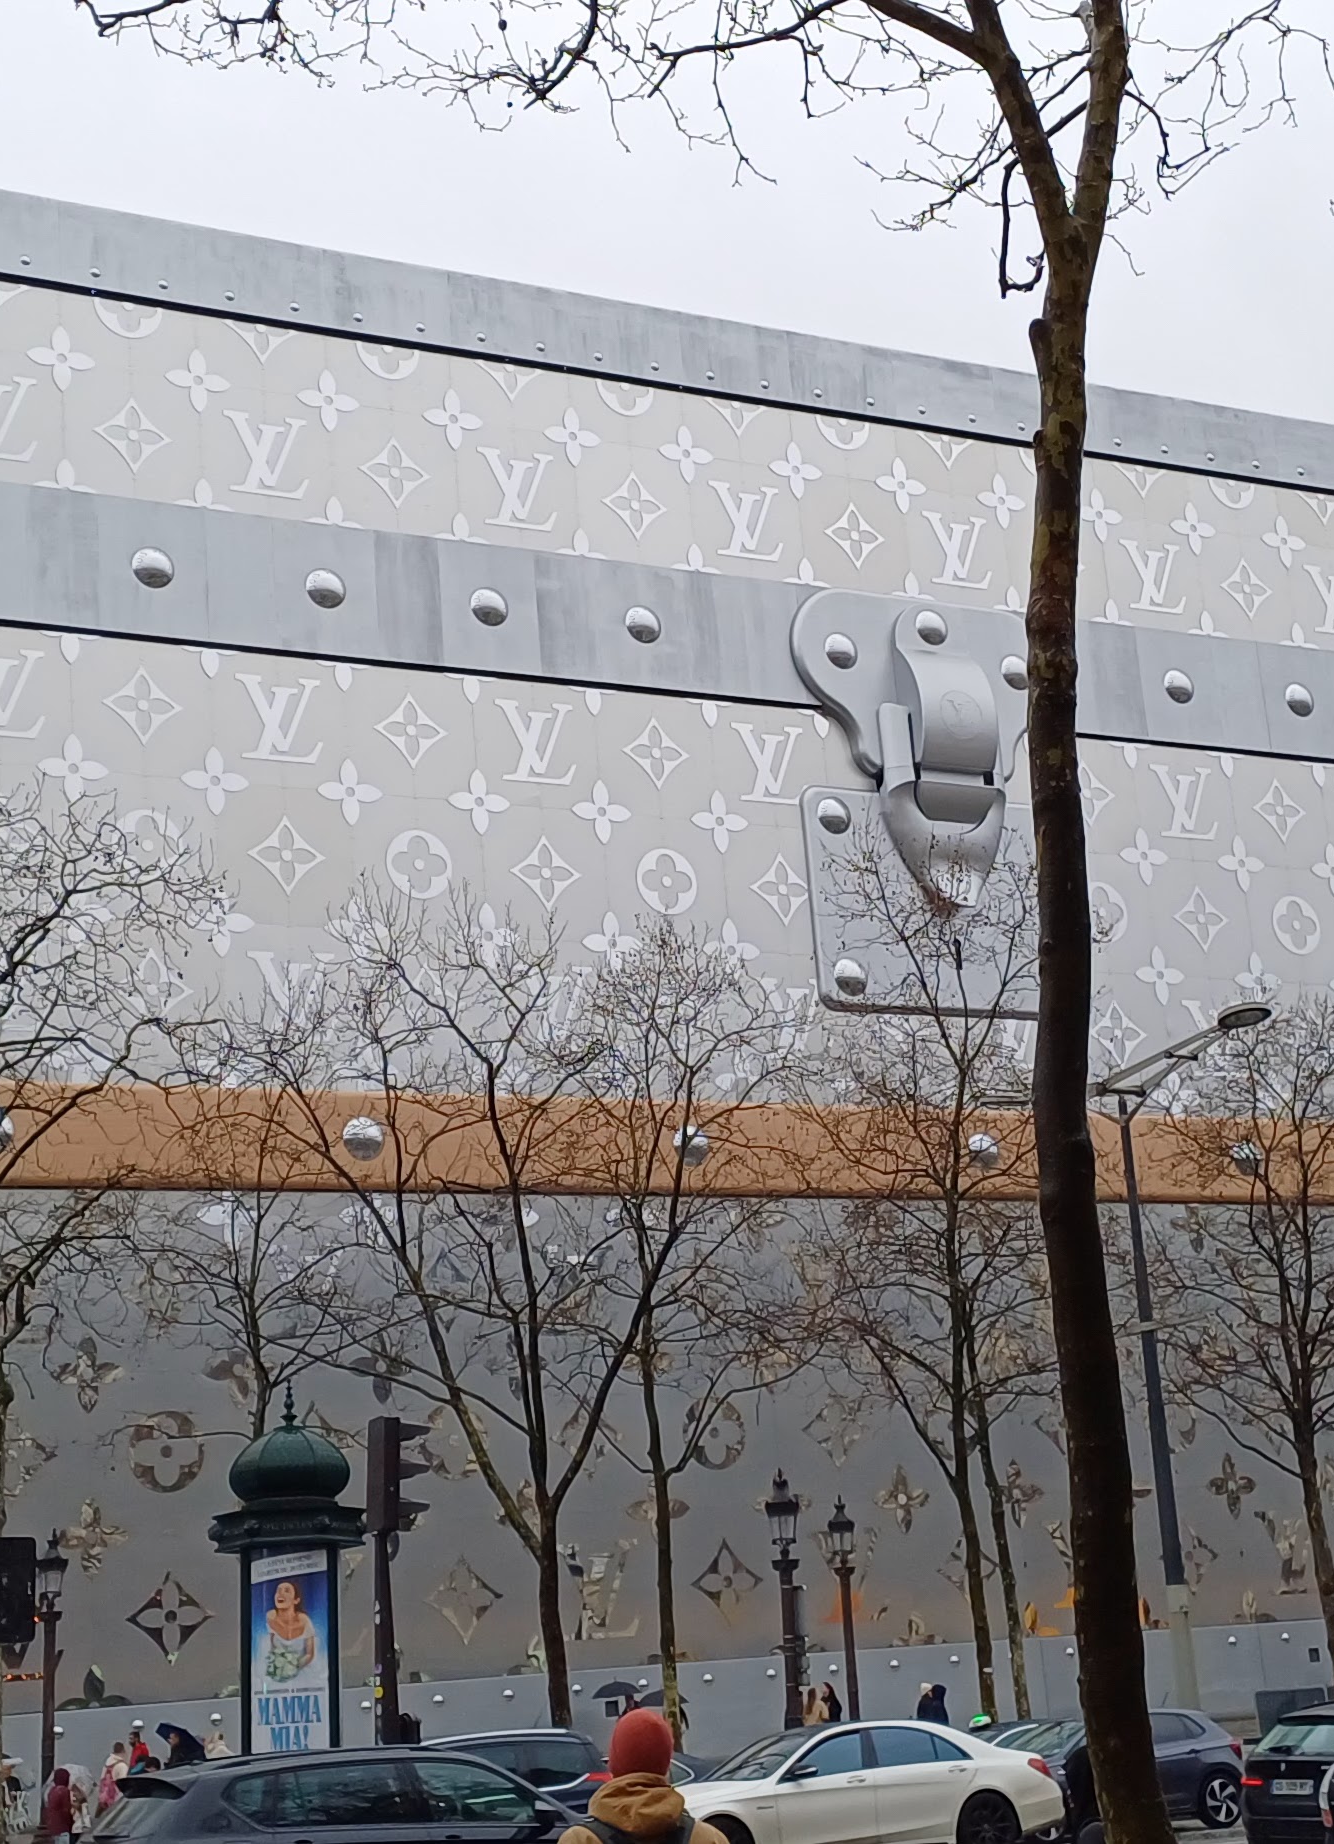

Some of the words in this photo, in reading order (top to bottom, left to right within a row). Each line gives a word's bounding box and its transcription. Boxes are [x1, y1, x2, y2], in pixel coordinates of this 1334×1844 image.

[222, 409, 309, 500] LV
[477, 446, 557, 532] LV
[708, 480, 783, 562] LV
[922, 510, 993, 590] LV
[1119, 538, 1186, 615] LV
[233, 672, 324, 765] LV
[494, 698, 577, 786] LV
[1149, 763, 1219, 841] LV
[257, 1694, 322, 1726] MAMMA
[270, 1724, 309, 1751] MIA!
